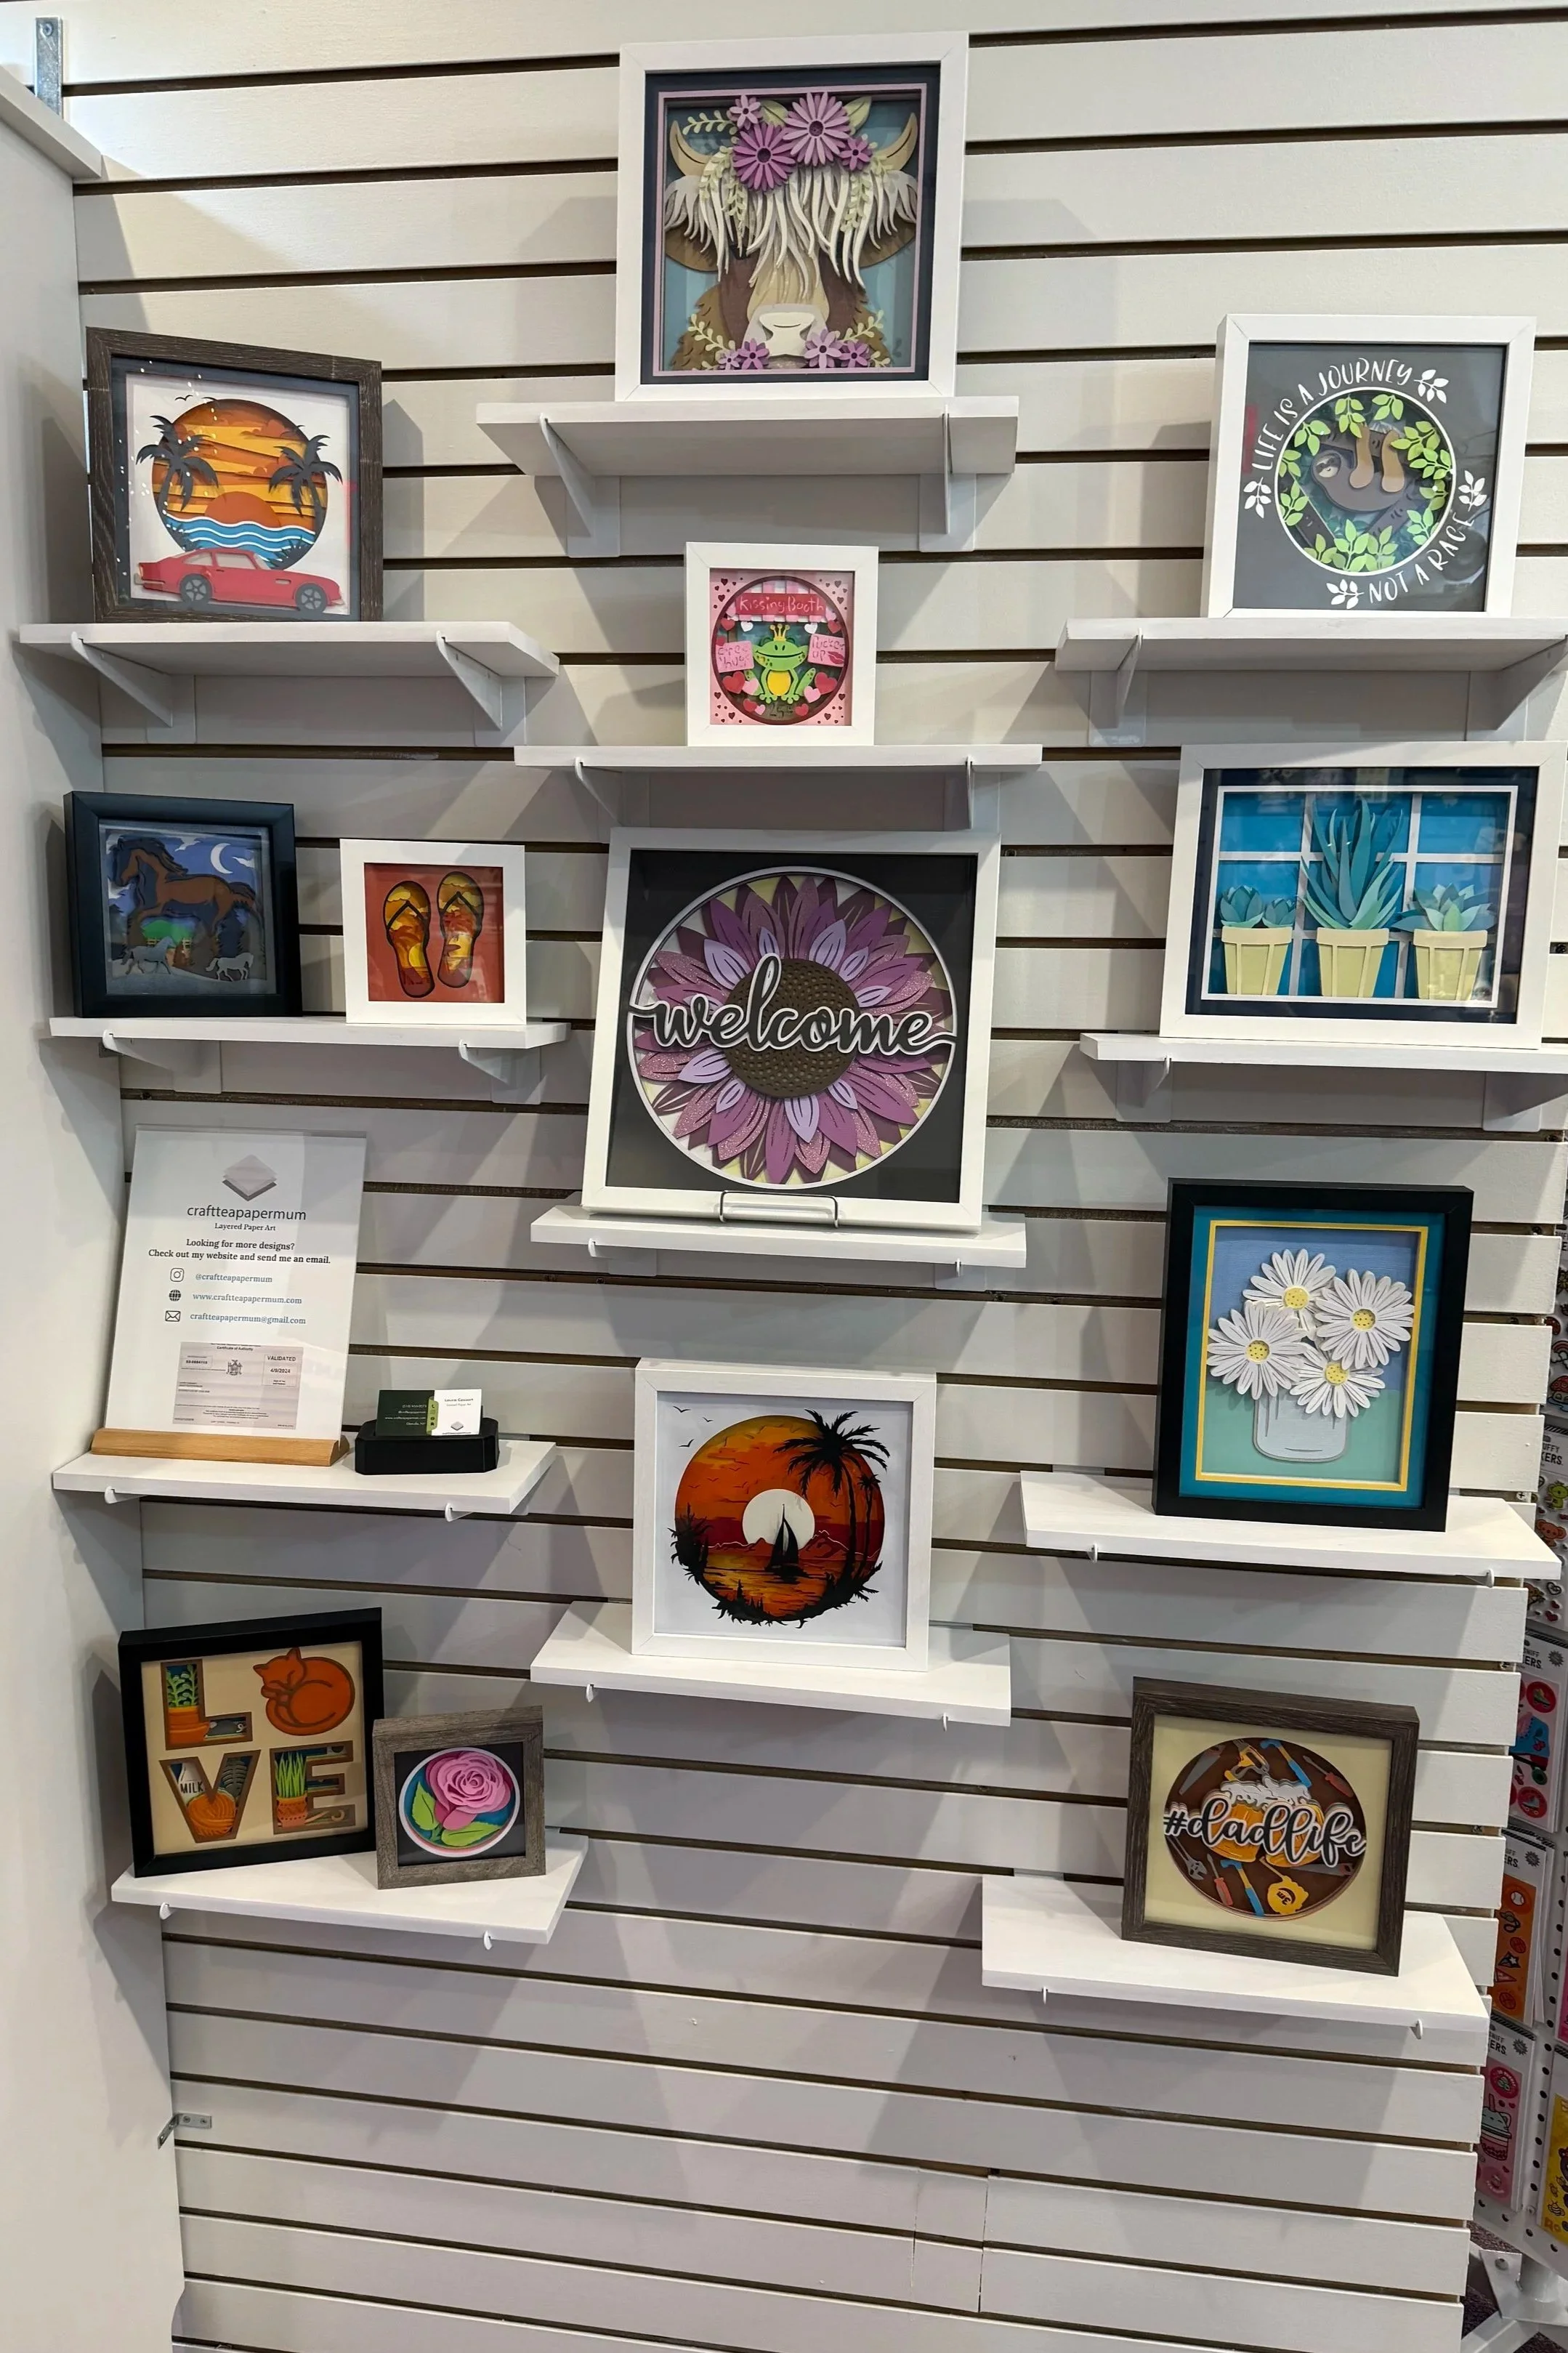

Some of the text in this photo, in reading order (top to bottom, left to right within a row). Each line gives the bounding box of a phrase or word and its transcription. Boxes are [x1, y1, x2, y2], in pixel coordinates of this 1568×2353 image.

[1251, 357, 1413, 471] LIFE IS A JOURNEY
[1369, 512, 1475, 604] NOT A RACE
[787, 595, 825, 613] Booth
[629, 953, 958, 1057] welcome
[187, 1204, 307, 1221] craftteapapermum
[214, 1222, 243, 1231] Layered
[186, 1238, 219, 1249] Looking
[221, 1239, 234, 1248] for
[259, 1241, 295, 1251] designs?
[148, 1248, 174, 1258] Check
[191, 1252, 204, 1261] my
[206, 1251, 238, 1261] website
[240, 1253, 255, 1262] and
[256, 1254, 277, 1262] send
[305, 1255, 331, 1264] email.
[195, 1273, 273, 1284] @craftteapapermum
[192, 1293, 303, 1305] www.craftteapapermum.com
[190, 1312, 307, 1325] craftteapapermum@gmail.com
[179, 1780, 204, 1794] MILK
[1163, 1796, 1366, 1868] #dadlife
